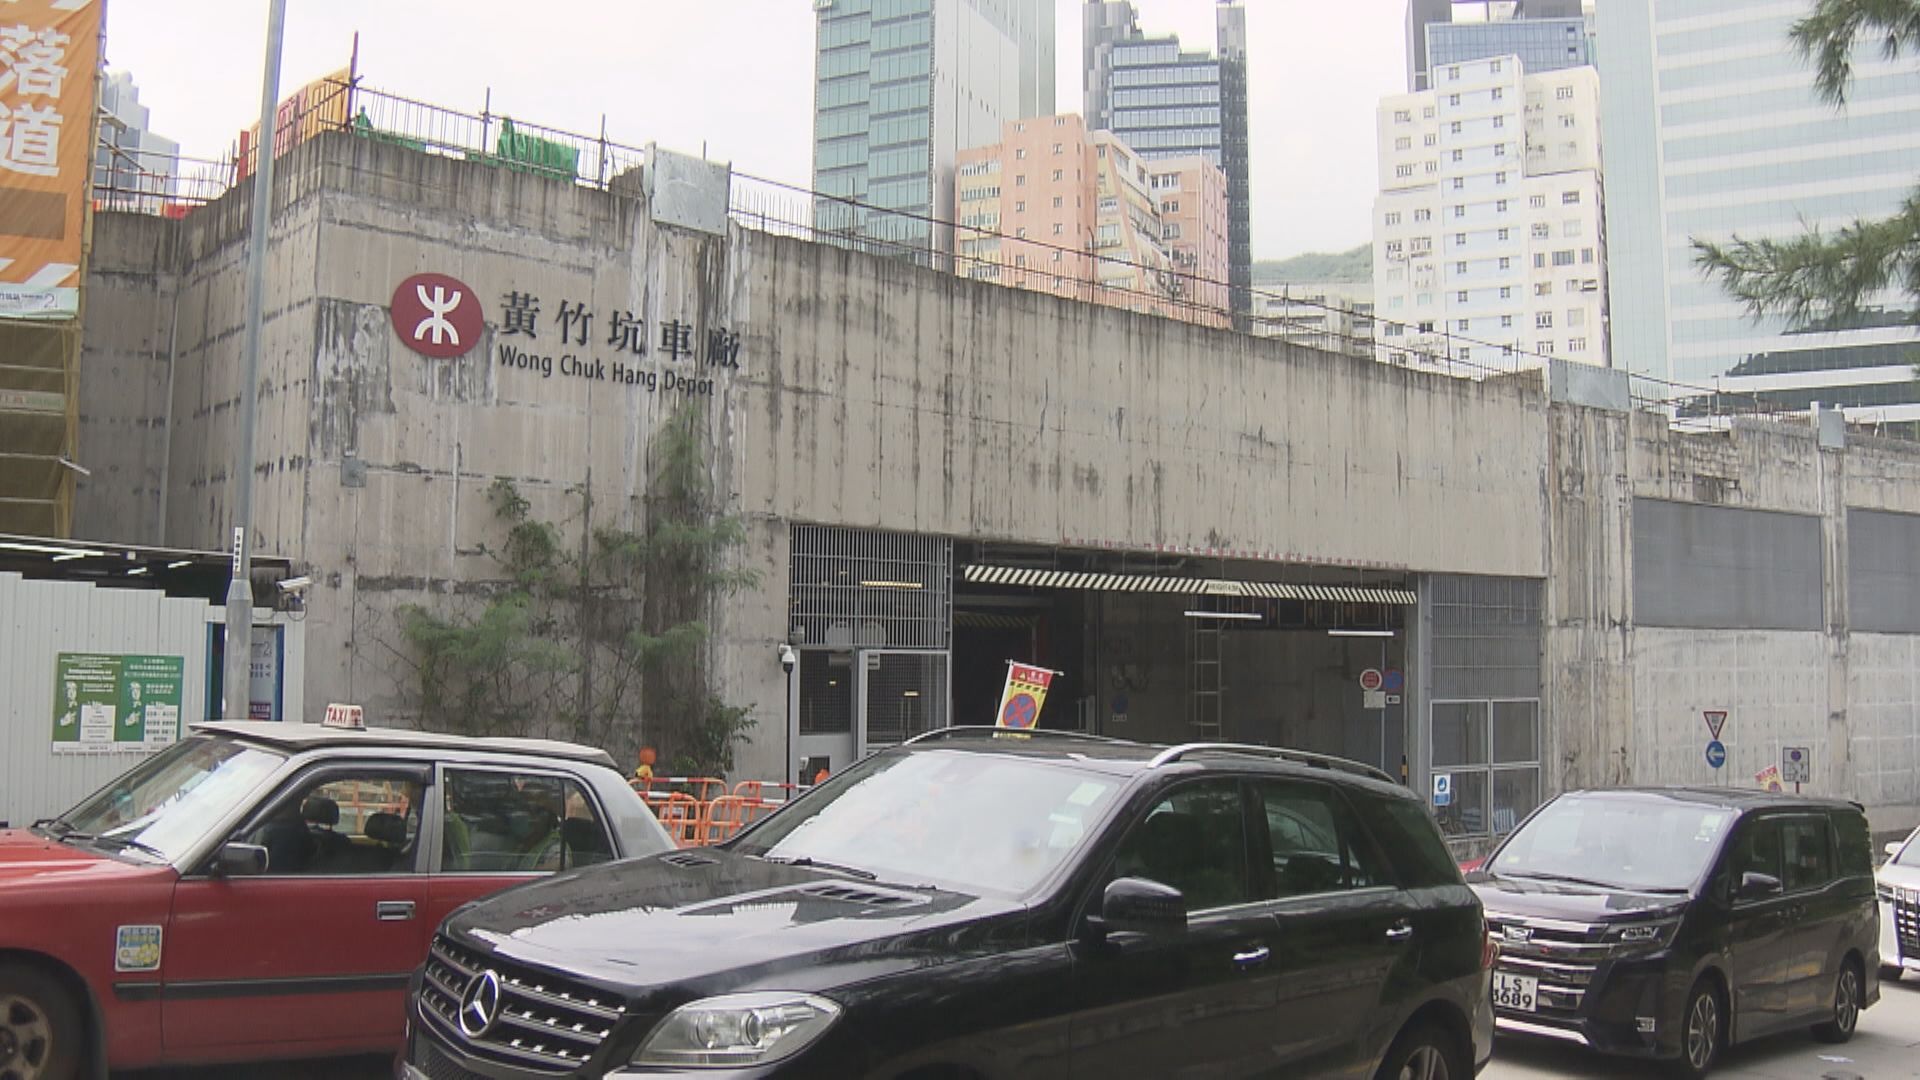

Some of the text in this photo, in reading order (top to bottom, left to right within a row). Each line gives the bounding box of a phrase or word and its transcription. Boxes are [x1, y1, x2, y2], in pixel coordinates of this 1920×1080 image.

[0, 103, 64, 177] 道
[500, 290, 740, 370] 黃竹坑車廠
[499, 344, 714, 396] Wong Chuk Hang Depot
[328, 706, 347, 724] TAXI
[1501, 975, 1522, 991] LS
